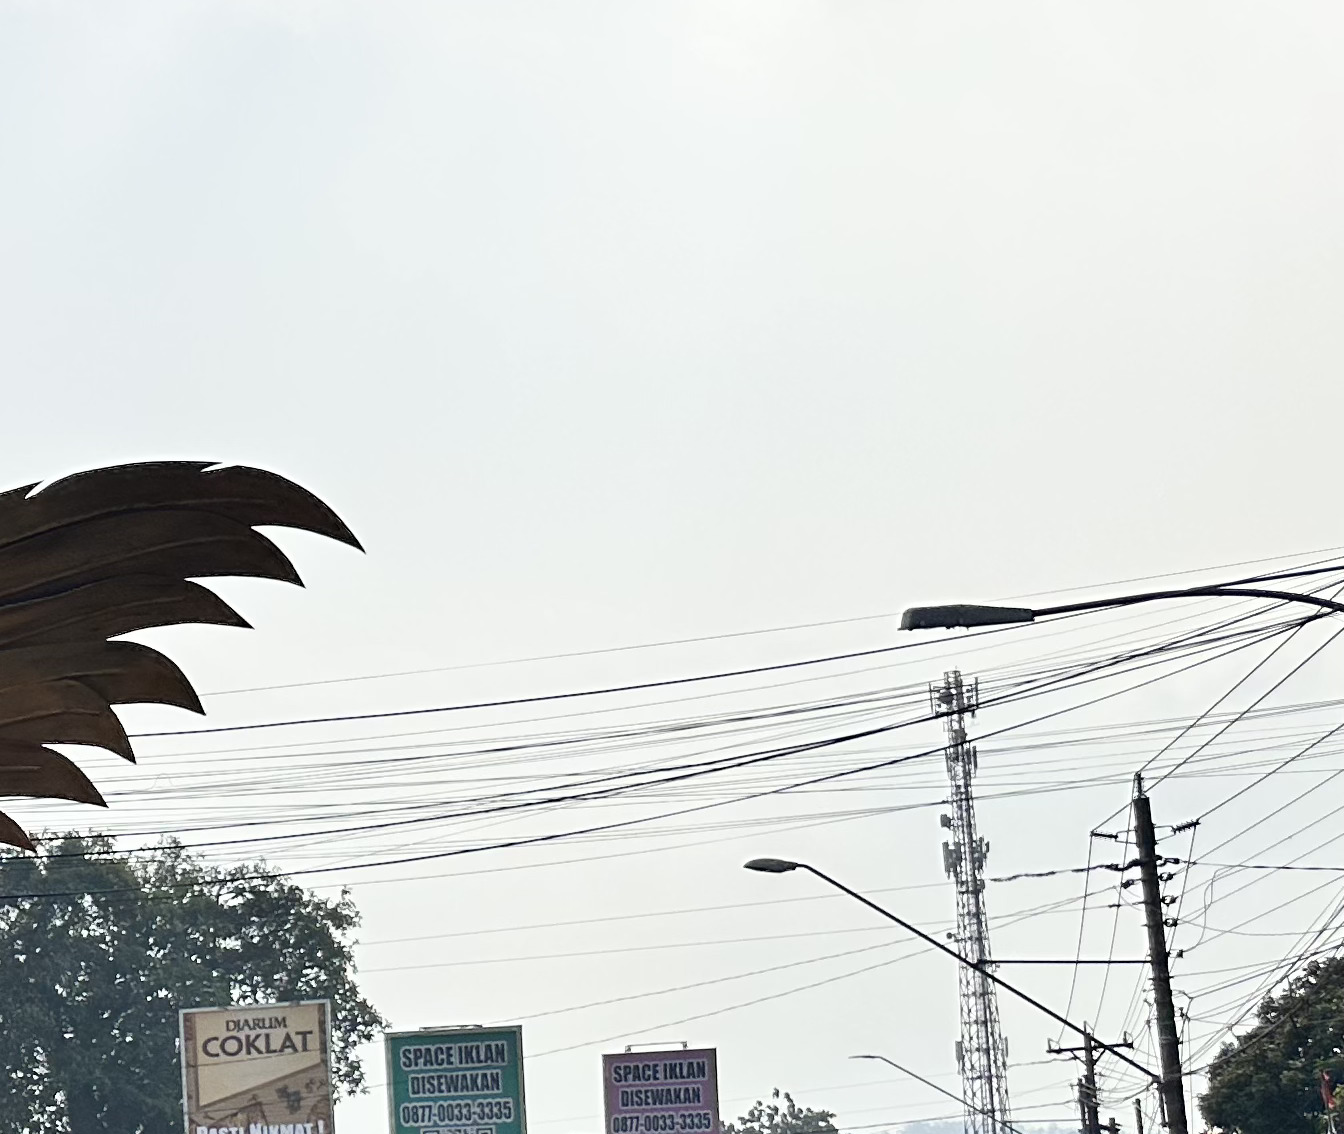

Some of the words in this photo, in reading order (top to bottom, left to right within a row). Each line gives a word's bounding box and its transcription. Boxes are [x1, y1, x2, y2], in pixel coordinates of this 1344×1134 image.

[226, 1017, 287, 1032] DJARUM
[202, 1031, 313, 1058] COKLAT
[402, 1046, 454, 1068] SPACE
[458, 1043, 505, 1064] IKLAN
[613, 1063, 659, 1083] SPACE
[663, 1061, 706, 1080] IKLAN
[411, 1072, 501, 1095] DISEWAKAN
[621, 1087, 701, 1107] DISEWAKAN
[402, 1101, 512, 1124] 0877-0033-3335
[613, 1113, 711, 1133] 0877-0033-3335
